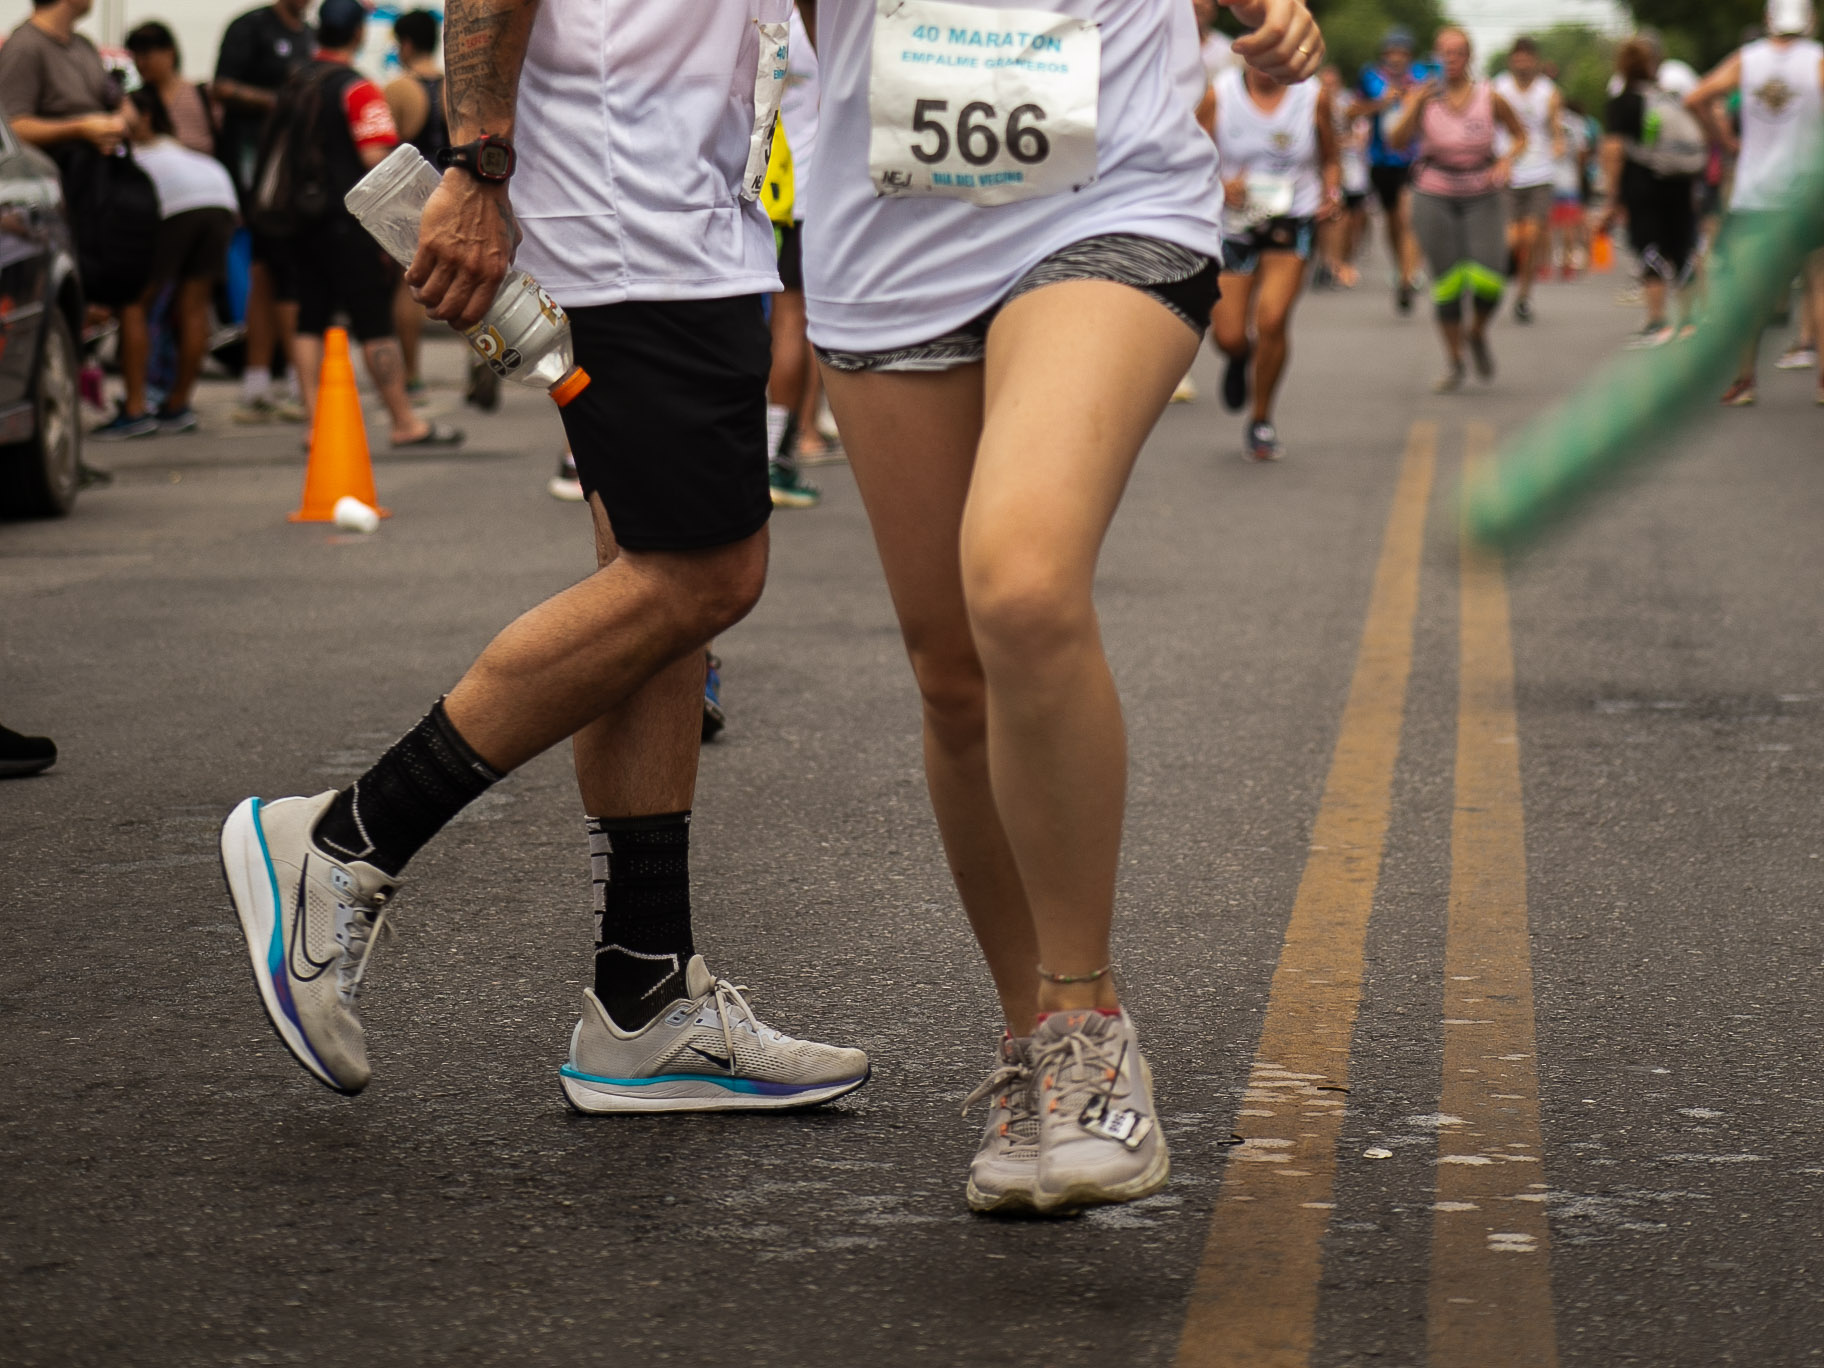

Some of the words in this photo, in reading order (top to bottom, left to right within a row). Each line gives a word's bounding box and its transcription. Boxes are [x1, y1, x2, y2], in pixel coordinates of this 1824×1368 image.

[912, 24, 940, 43] 40
[947, 27, 1063, 53] MARATON
[901, 50, 979, 69] EMPALME
[910, 98, 1050, 167] 566
